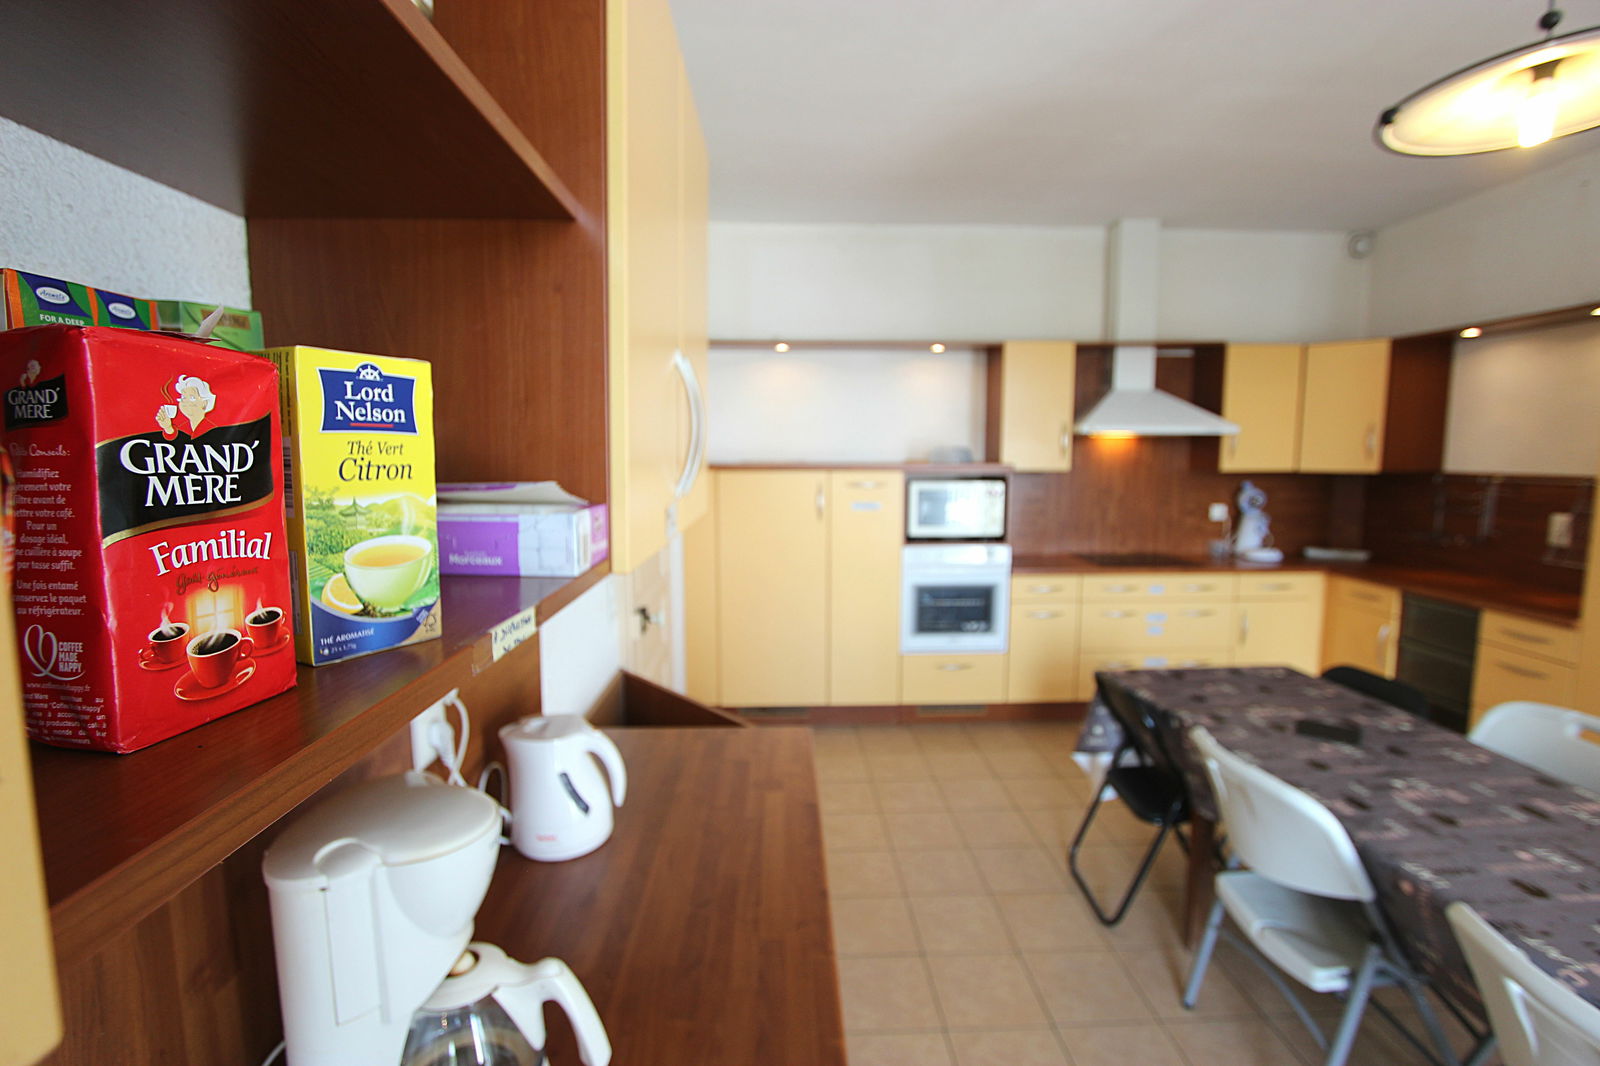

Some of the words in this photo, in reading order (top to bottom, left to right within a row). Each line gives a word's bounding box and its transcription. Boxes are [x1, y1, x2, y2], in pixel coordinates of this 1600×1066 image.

[40, 313, 56, 323] FOR
[65, 318, 85, 327] DEEP
[344, 381, 394, 402] Lord
[334, 401, 406, 423] Nelson
[347, 440, 373, 455] Thé
[377, 441, 404, 457] Vert
[120, 439, 259, 474] GRAND'
[338, 457, 413, 482] Citron
[49, 483, 72, 491] votre
[56, 494, 66, 504] de
[14, 508, 34, 517] ettre
[35, 508, 55, 517] votre
[26, 520, 45, 530] Pour
[20, 533, 46, 546] dosage
[58, 550, 82, 560] soupe
[148, 529, 272, 576] Familial
[16, 561, 30, 572] par
[31, 561, 50, 570] tasse
[16, 580, 32, 589] Une
[32, 580, 47, 591] fois
[48, 581, 79, 590] entamé
[49, 593, 57, 602] le
[59, 595, 87, 605] paquet
[59, 642, 83, 652] COFFEE
[59, 652, 78, 662] MADE
[59, 662, 81, 672] HAPPY
